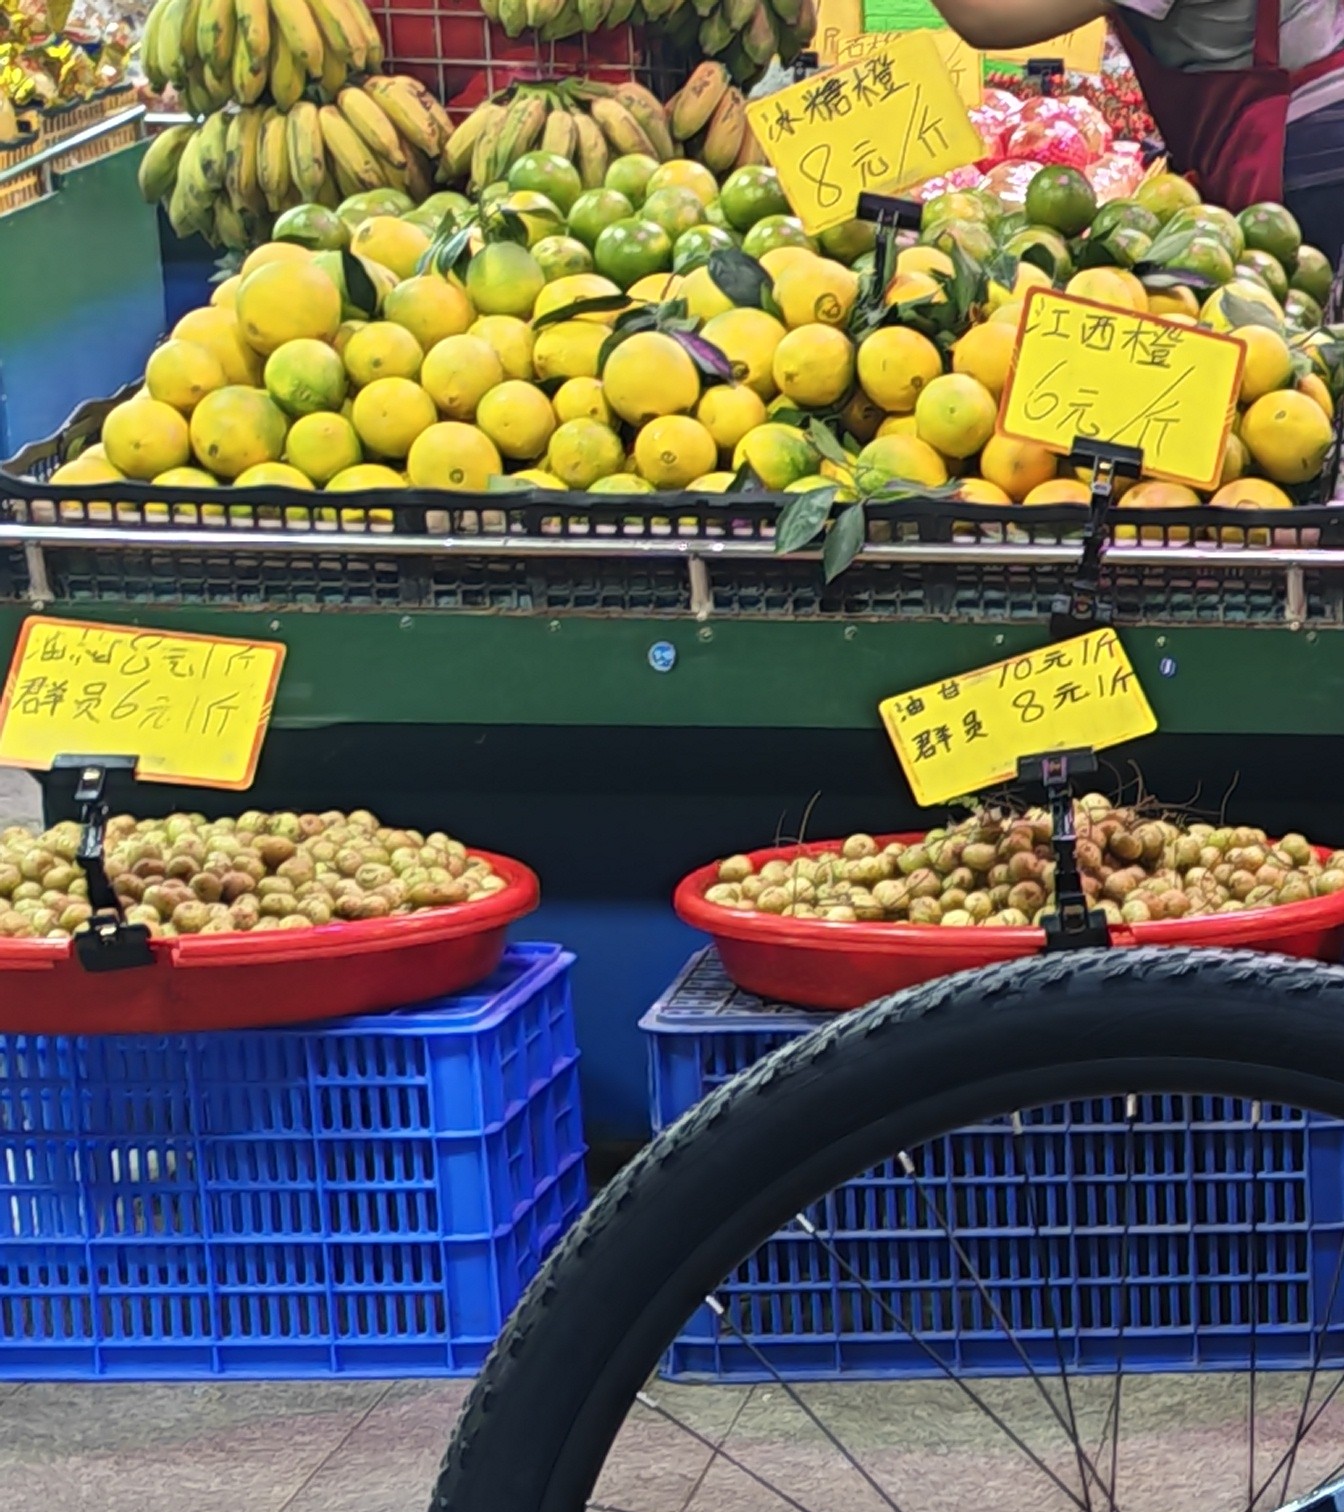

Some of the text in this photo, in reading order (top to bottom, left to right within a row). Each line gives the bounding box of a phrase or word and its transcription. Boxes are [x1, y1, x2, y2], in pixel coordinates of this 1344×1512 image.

[799, 84, 949, 209] 8元/斤
[1025, 297, 1185, 370] 江西橙
[1024, 359, 1197, 458] 6元/斤
